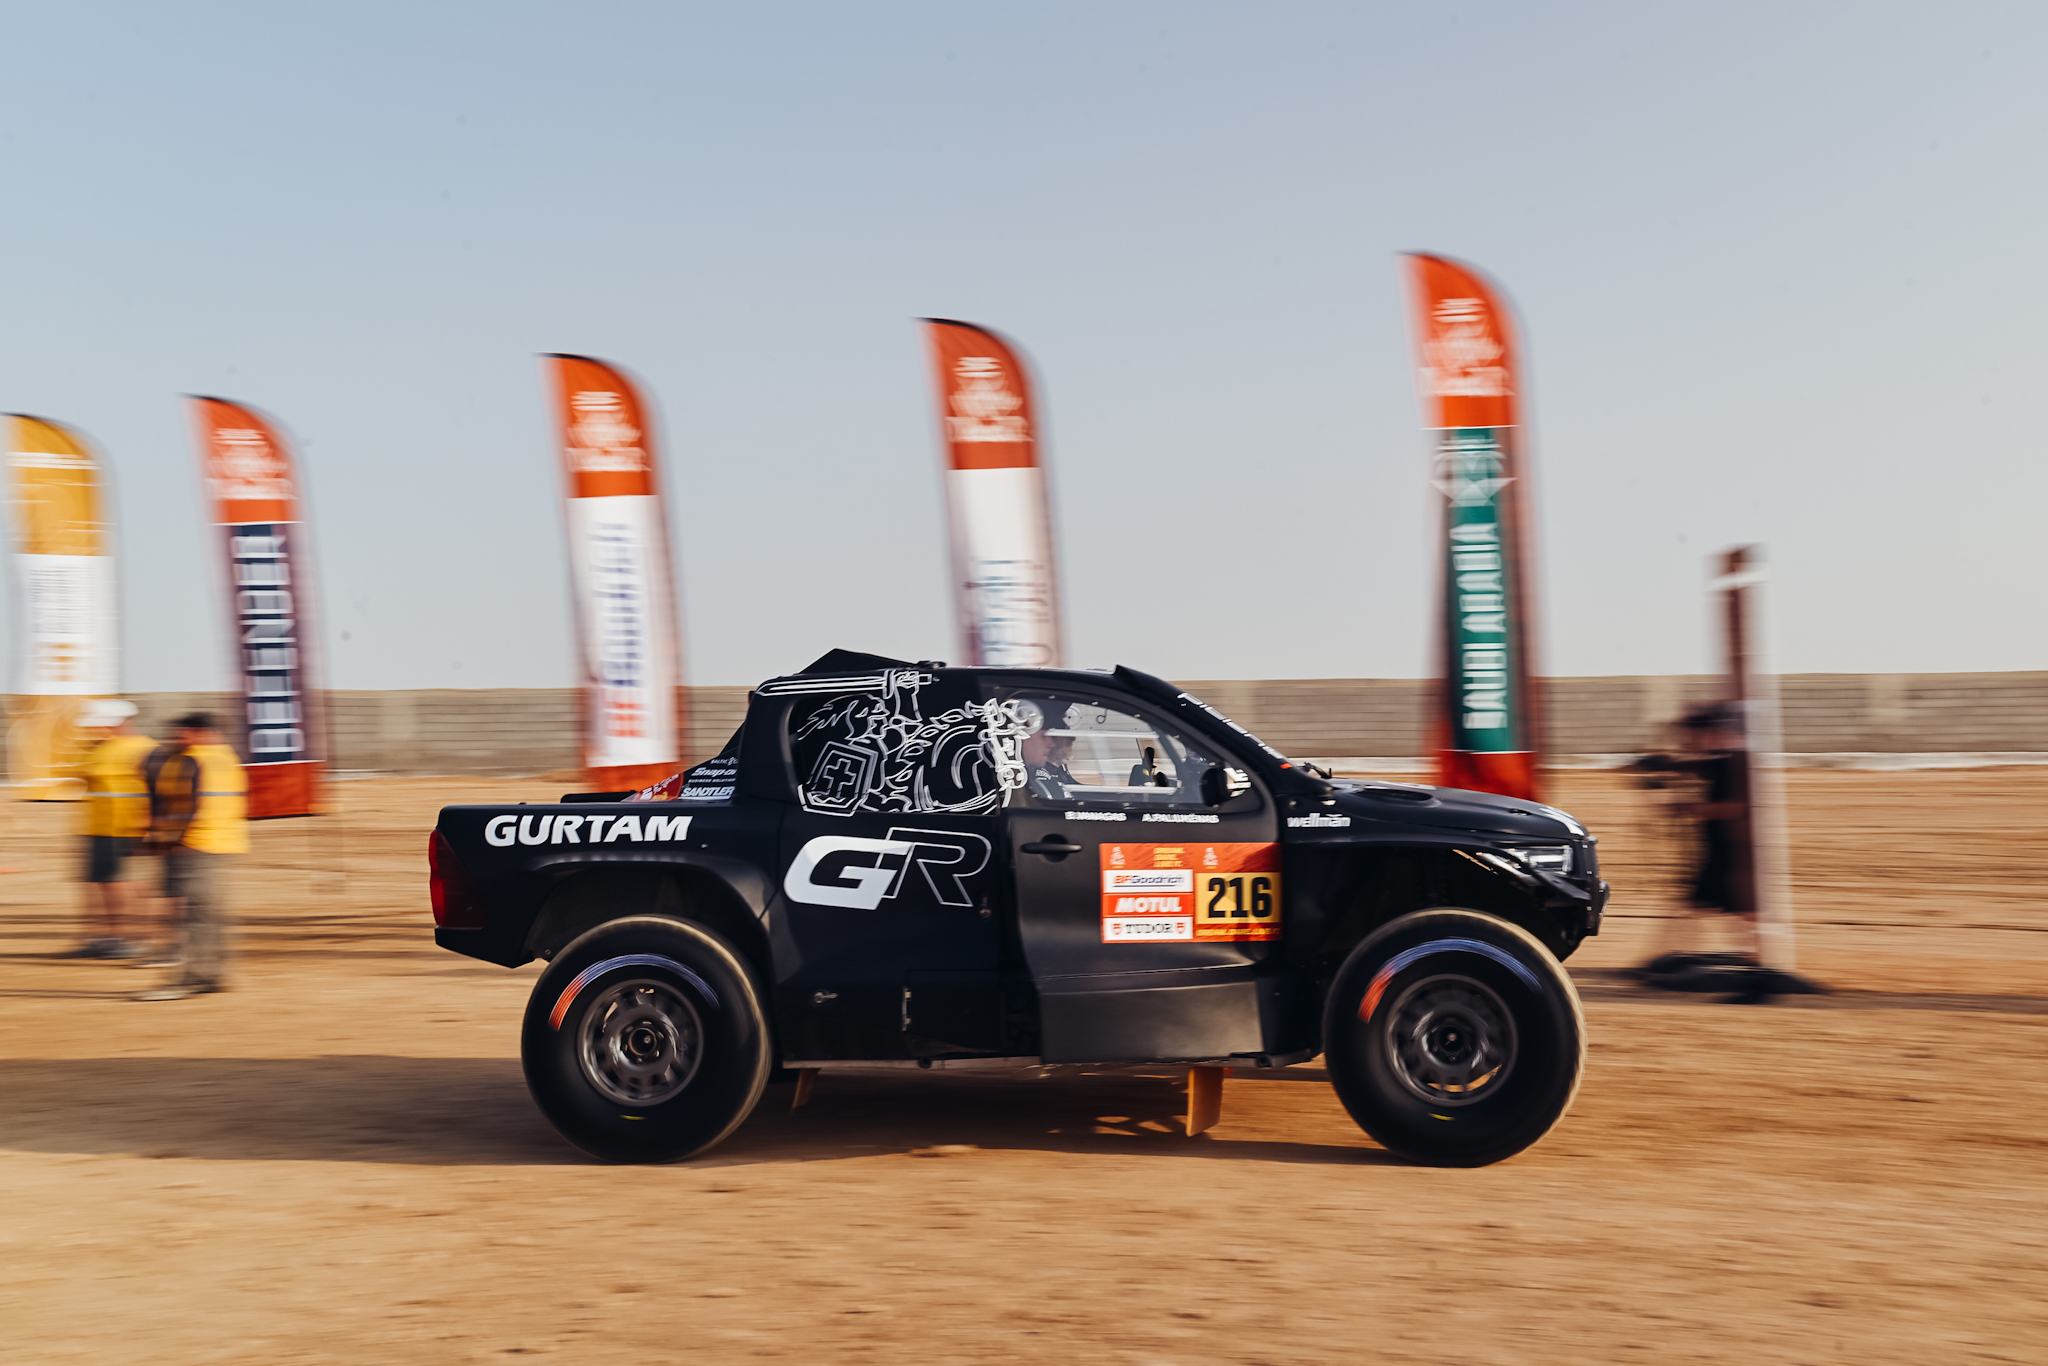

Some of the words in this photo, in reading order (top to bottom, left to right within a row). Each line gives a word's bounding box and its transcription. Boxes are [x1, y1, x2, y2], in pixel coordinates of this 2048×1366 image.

[1449, 522, 1508, 634] ARABIA
[1460, 642, 1508, 730] SAUDI
[485, 815, 693, 848] GURTAM
[1114, 875, 1184, 884] BFGoodrich
[1115, 897, 1182, 913] MOTUL
[1208, 877, 1271, 918] 216
[1125, 923, 1173, 934] TUDOR
